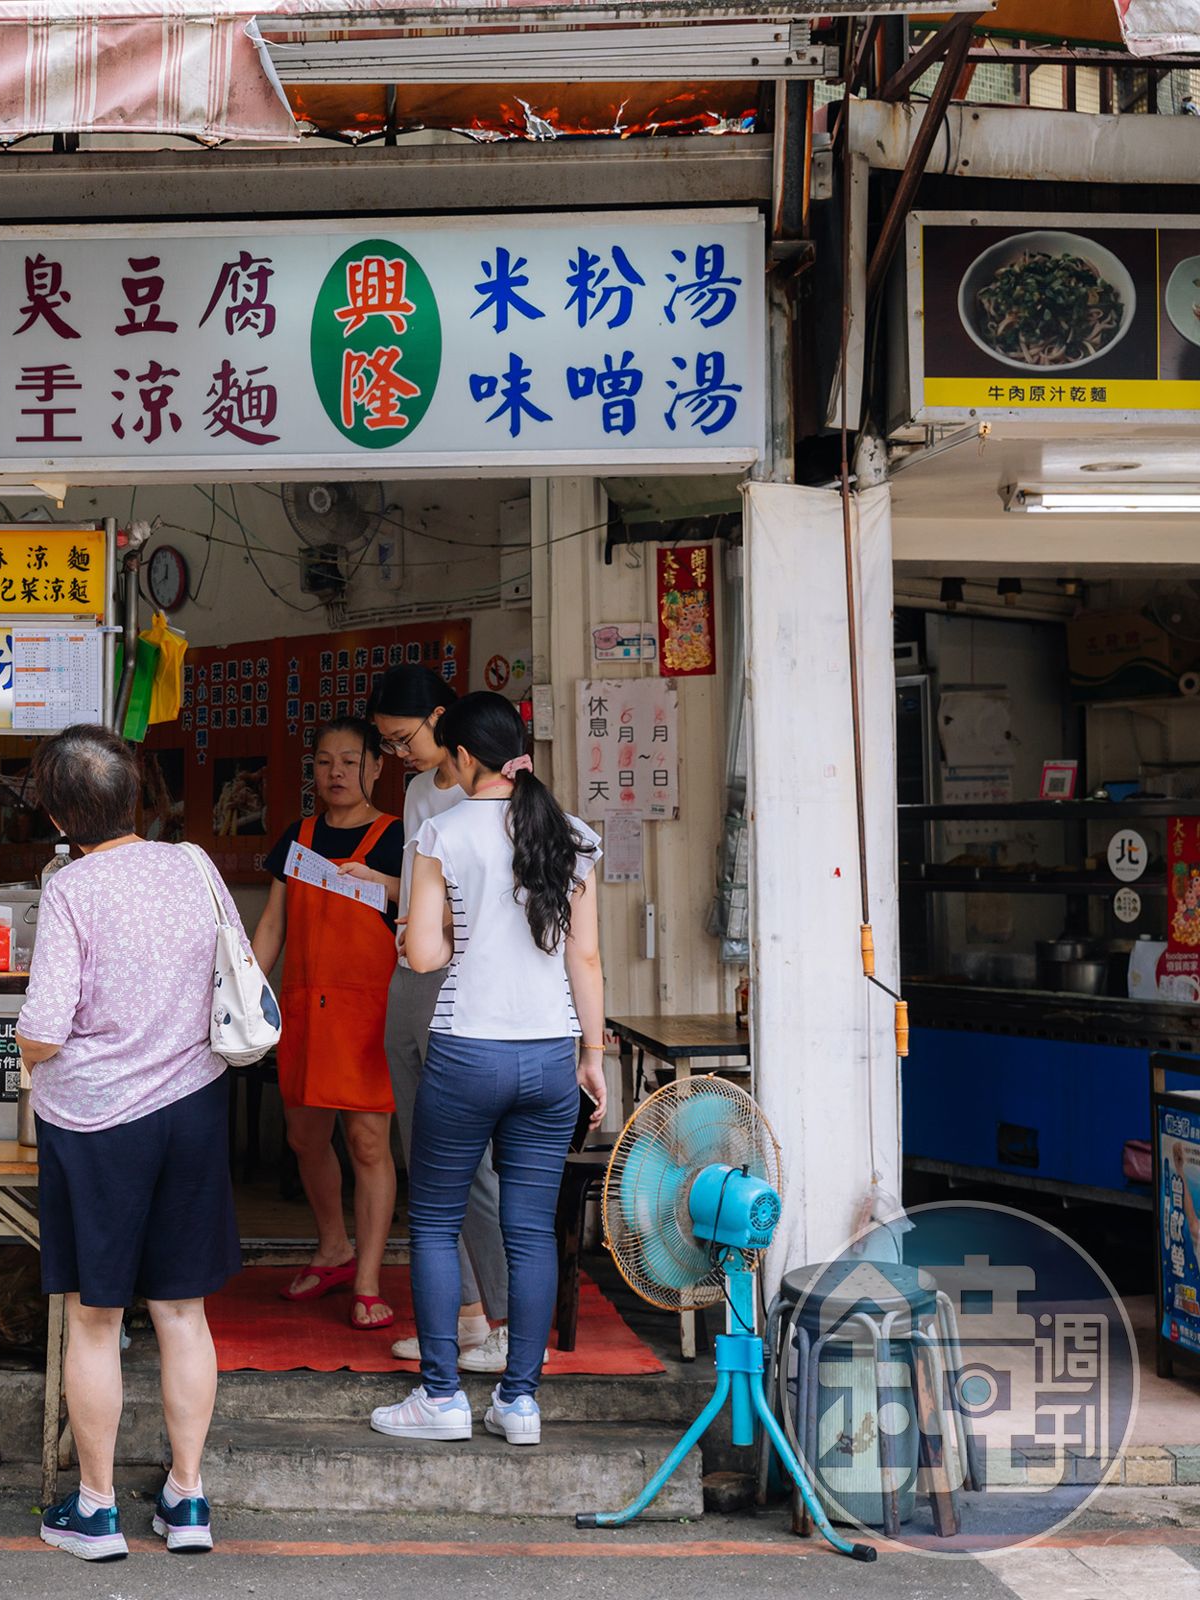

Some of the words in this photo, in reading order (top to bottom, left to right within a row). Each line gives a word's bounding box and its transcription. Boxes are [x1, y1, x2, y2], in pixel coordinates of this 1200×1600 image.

[12, 249, 276, 340] 臭豆腐
[469, 242, 743, 335] 米粉湯
[332, 255, 422, 432] 興隆
[13, 359, 282, 445] 手工涼麵
[469, 348, 744, 438] 味噌湯
[987, 385, 1108, 403] 牛肉原汁乾麵
[662, 550, 679, 587] 大吉
[226, 660, 239, 729] 貢丸湯
[240, 658, 254, 728] 味噌湯
[256, 656, 270, 727] 米粉湯
